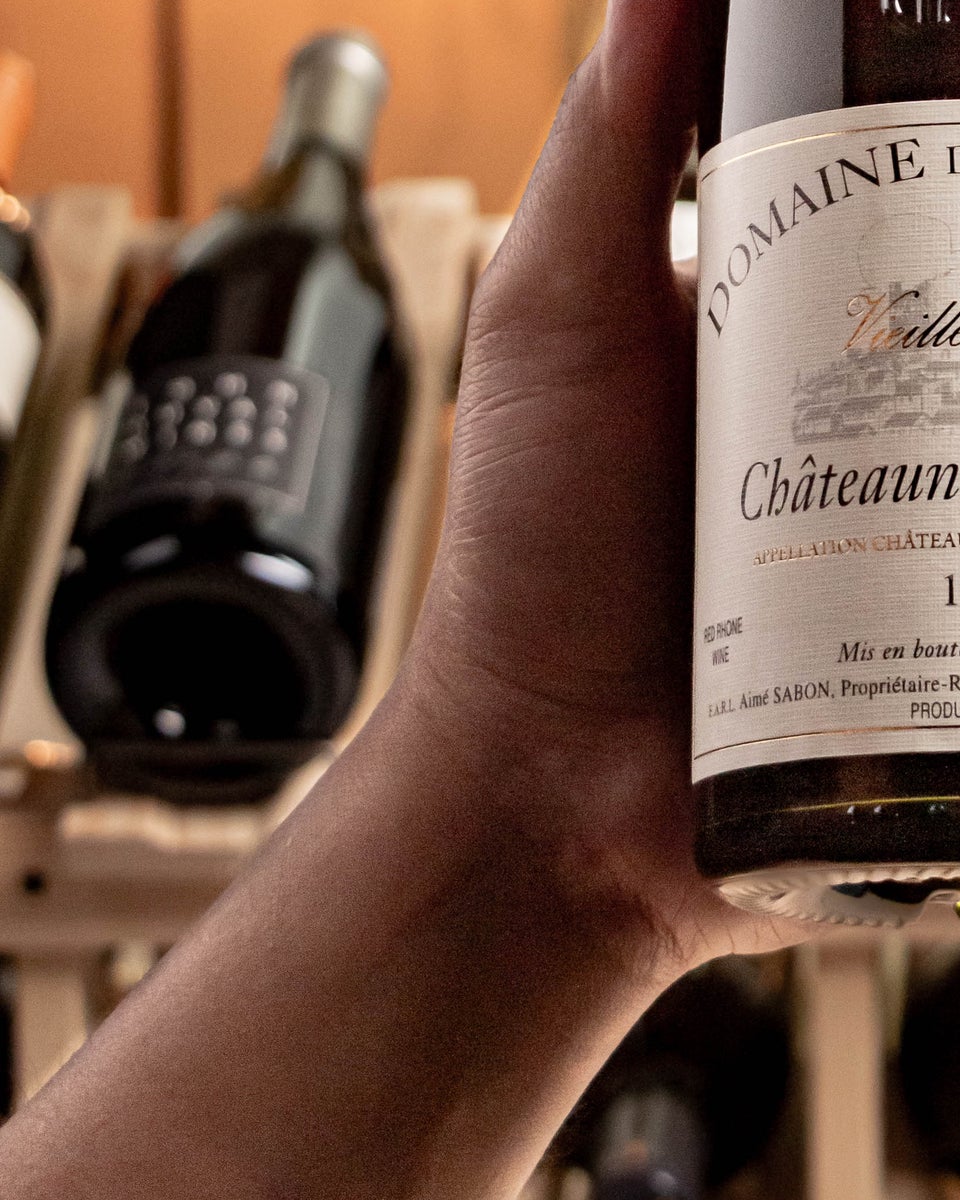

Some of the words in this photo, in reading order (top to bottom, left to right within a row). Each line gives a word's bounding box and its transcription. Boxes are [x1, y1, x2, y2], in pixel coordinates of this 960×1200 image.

[707, 138, 925, 338] DOMAINE
[752, 536, 868, 566] APPELLATION
[703, 624, 716, 644] RED
[716, 616, 743, 640] RHONE
[712, 645, 730, 666] WINE
[837, 641, 874, 662] Mis
[882, 644, 905, 660] en
[739, 689, 769, 710] Aimé
